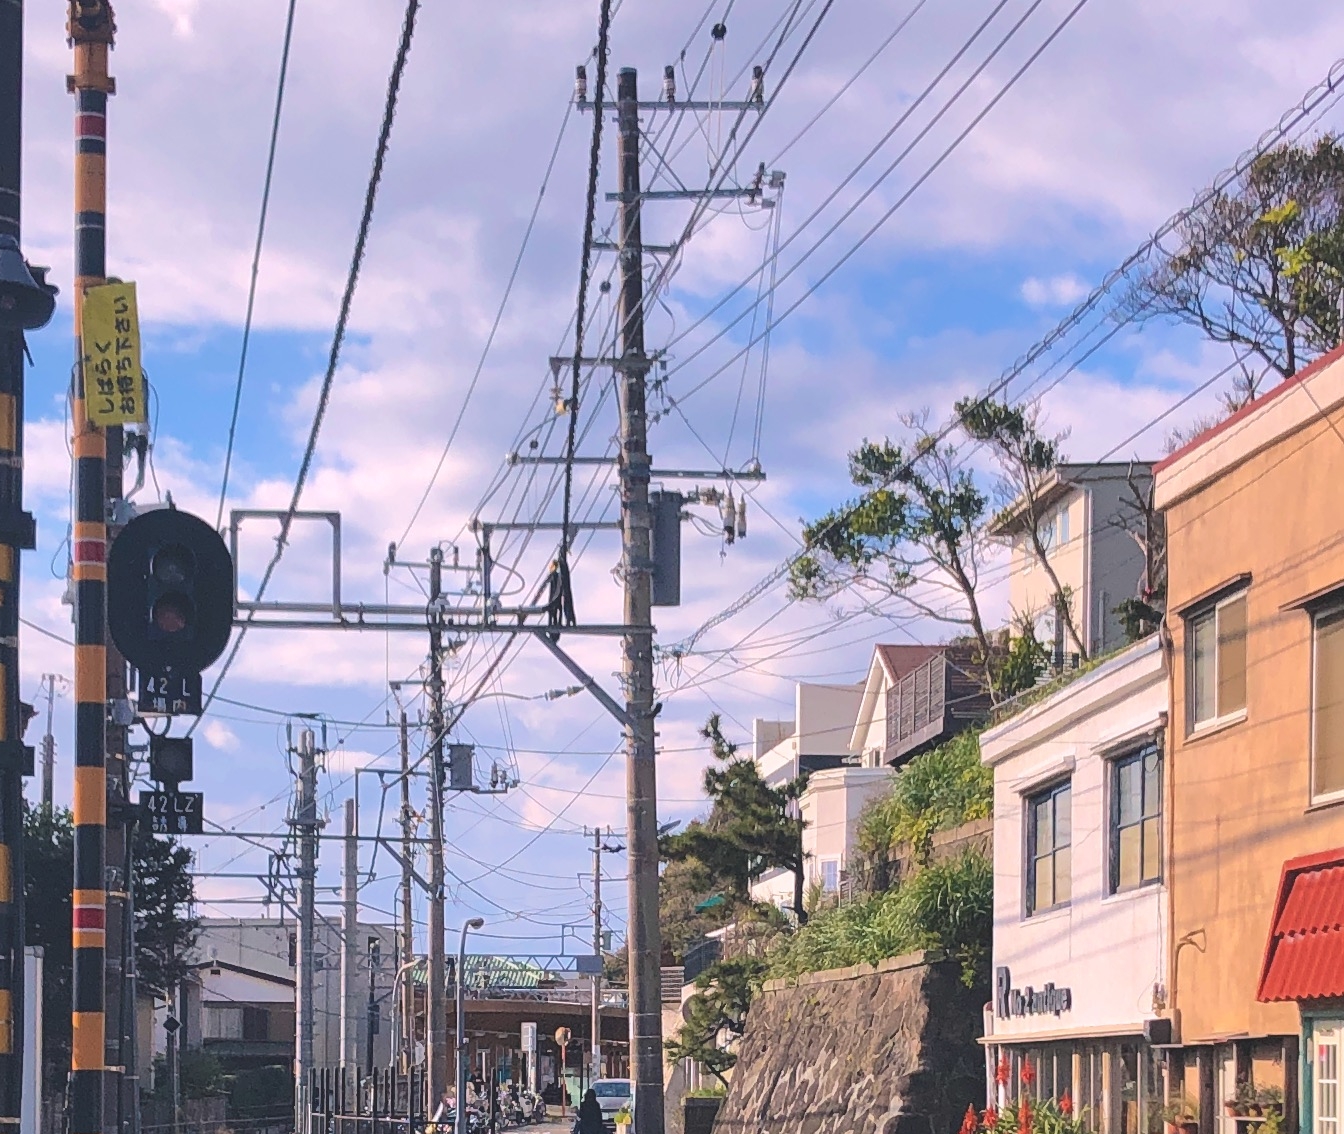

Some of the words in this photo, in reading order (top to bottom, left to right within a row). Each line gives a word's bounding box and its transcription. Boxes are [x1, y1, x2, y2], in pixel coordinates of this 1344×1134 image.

[95, 340, 115, 414] しばらく
[113, 295, 136, 415] お待ち下さい
[146, 676, 168, 695] 42
[182, 678, 191, 697] L
